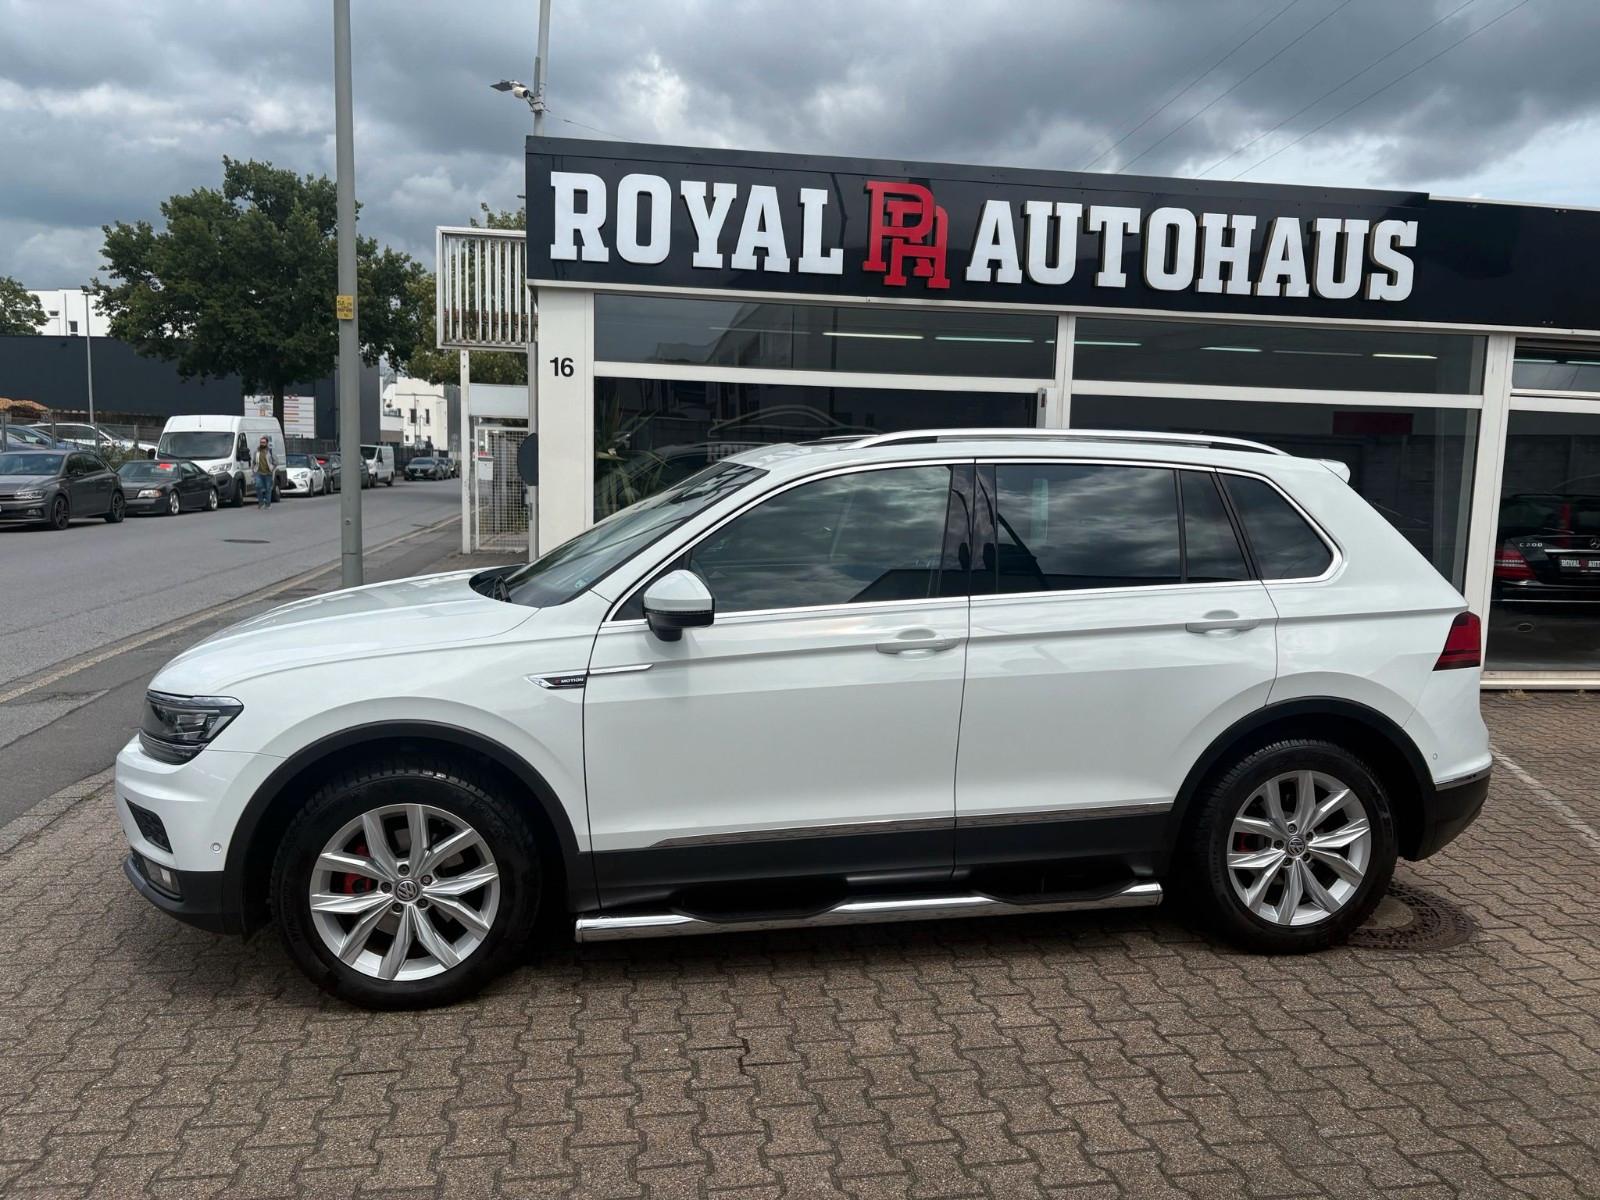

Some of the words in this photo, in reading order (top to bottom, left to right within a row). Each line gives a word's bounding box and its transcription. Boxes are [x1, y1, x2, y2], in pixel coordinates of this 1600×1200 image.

[549, 171, 844, 276] ROYAL
[966, 199, 1418, 302] AUTOHAUS
[550, 357, 574, 377] 16
